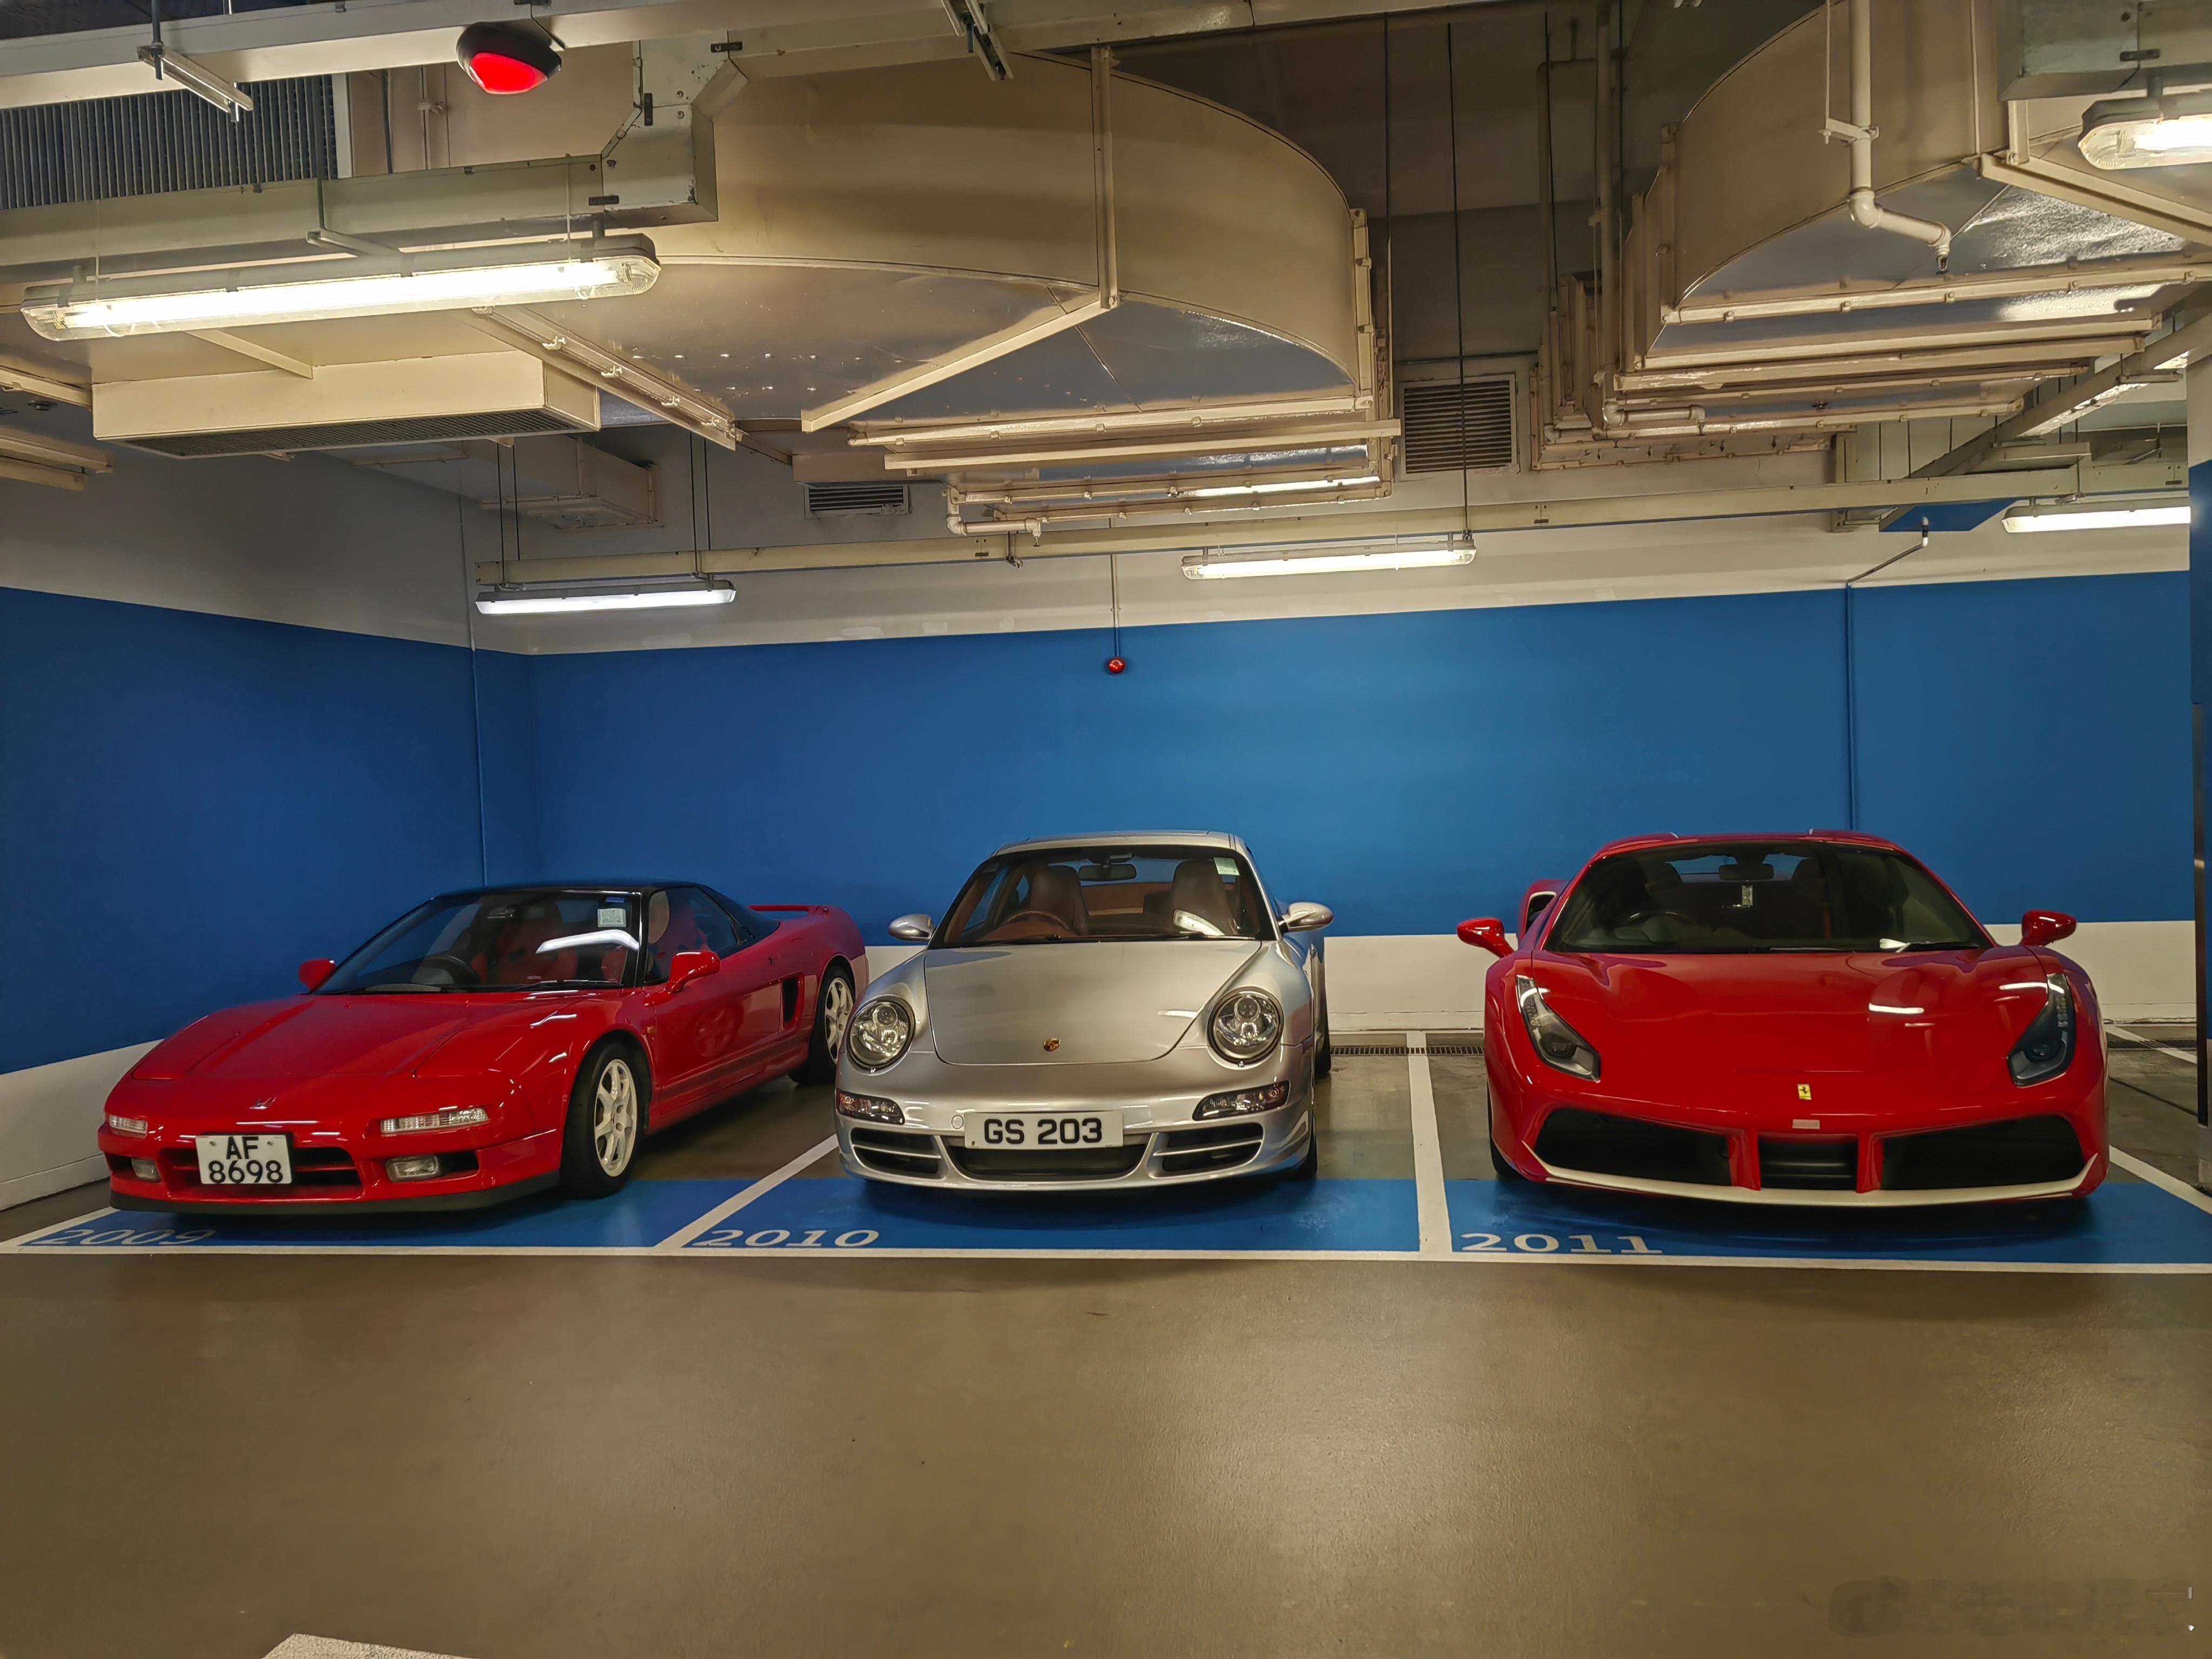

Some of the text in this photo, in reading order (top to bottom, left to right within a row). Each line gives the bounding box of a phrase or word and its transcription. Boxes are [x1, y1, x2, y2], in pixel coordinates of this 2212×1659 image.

[984, 1117, 1102, 1145] GS 203
[226, 1136, 259, 1159] AF
[208, 1159, 284, 1183] 8698
[31, 1229, 216, 1245] 2009
[691, 1229, 880, 1247] 2010
[1460, 1233, 1663, 1253] 2011
